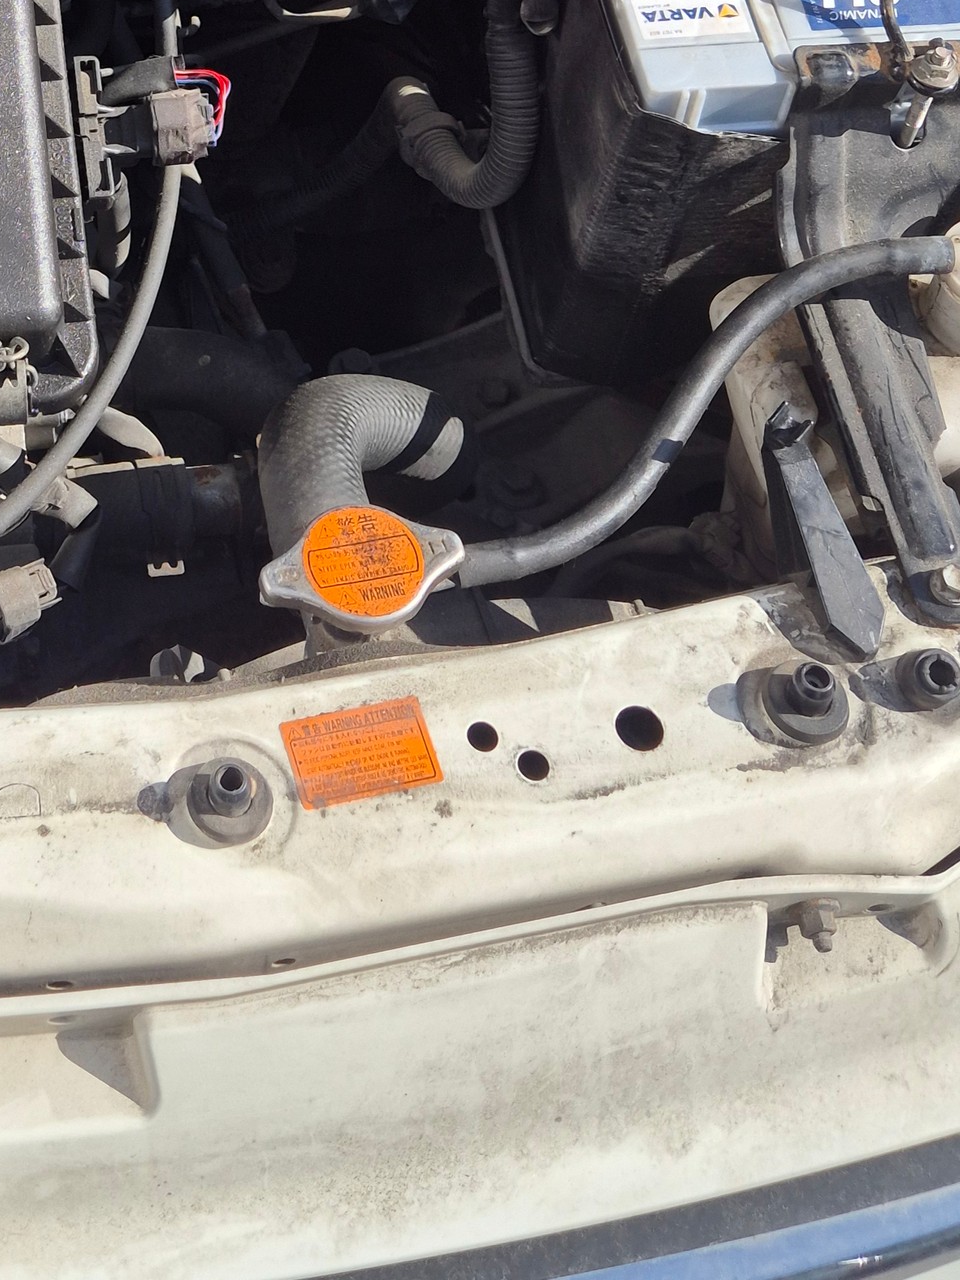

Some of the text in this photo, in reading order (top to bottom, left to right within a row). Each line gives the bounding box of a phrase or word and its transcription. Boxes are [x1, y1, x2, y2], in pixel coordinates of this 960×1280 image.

[641, 6, 715, 23] VARTA
[829, 6, 898, 21] NAMIC
[359, 582, 406, 602] WARNING
[323, 714, 363, 732] WARNING
[363, 704, 416, 724] ATTENTION
